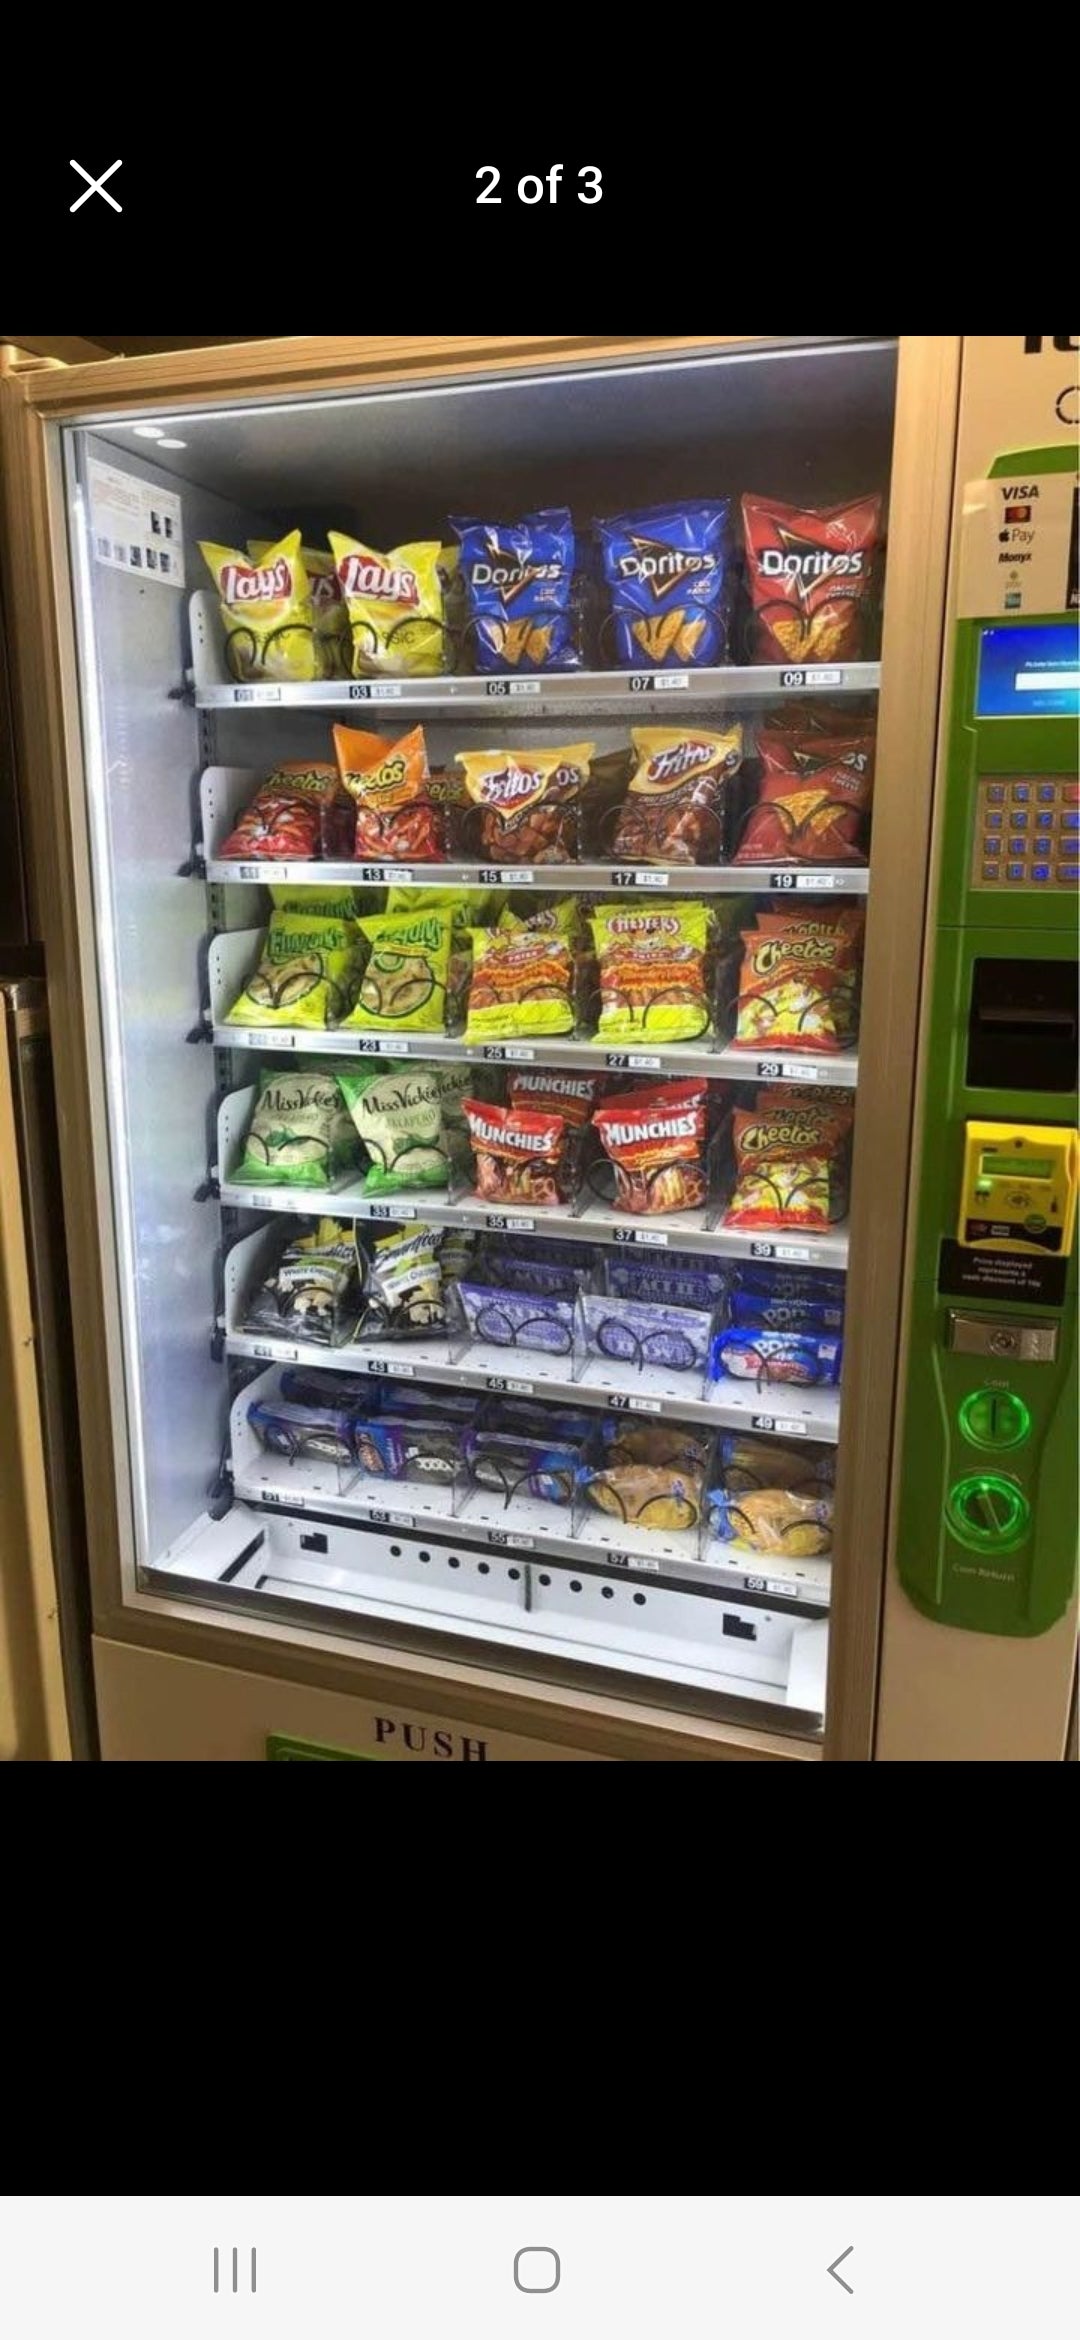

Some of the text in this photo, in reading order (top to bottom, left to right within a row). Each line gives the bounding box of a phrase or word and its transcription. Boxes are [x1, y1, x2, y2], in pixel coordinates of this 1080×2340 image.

[1002, 485, 1039, 500] VISA
[1012, 528, 1035, 544] Pay
[619, 551, 716, 577] Doritos
[763, 550, 863, 576] Doritos
[632, 677, 649, 690] 07
[783, 671, 804, 685] 09
[351, 686, 368, 698] 03
[488, 682, 506, 694] 05
[648, 740, 714, 781] Fritos
[366, 868, 382, 880] 13
[481, 870, 498, 883] 15
[614, 873, 632, 885] 17
[774, 875, 793, 888] 19
[754, 938, 835, 975] Cheetos
[487, 1047, 503, 1059] 25
[609, 1053, 625, 1066] 27
[761, 1063, 780, 1077] 29
[513, 1074, 596, 1100] MUNCHIES
[262, 1091, 299, 1112] Miss
[363, 1098, 399, 1115] Miss
[469, 1113, 553, 1152] MUNCHIES
[606, 1111, 697, 1147] MUNCHIES
[742, 1123, 821, 1151] Cheetos
[489, 1216, 505, 1228] 35
[615, 1228, 632, 1241] 37
[754, 1242, 772, 1256] 39
[995, 1260, 1033, 1270] displayed
[370, 1361, 386, 1373] 43
[488, 1377, 504, 1390] 45
[610, 1395, 626, 1408] 47
[755, 1416, 774, 1429] 49
[491, 1532, 505, 1543] 55
[611, 1552, 626, 1565] 57
[748, 1577, 764, 1591] 59
[374, 1716, 488, 1761] PUSH
